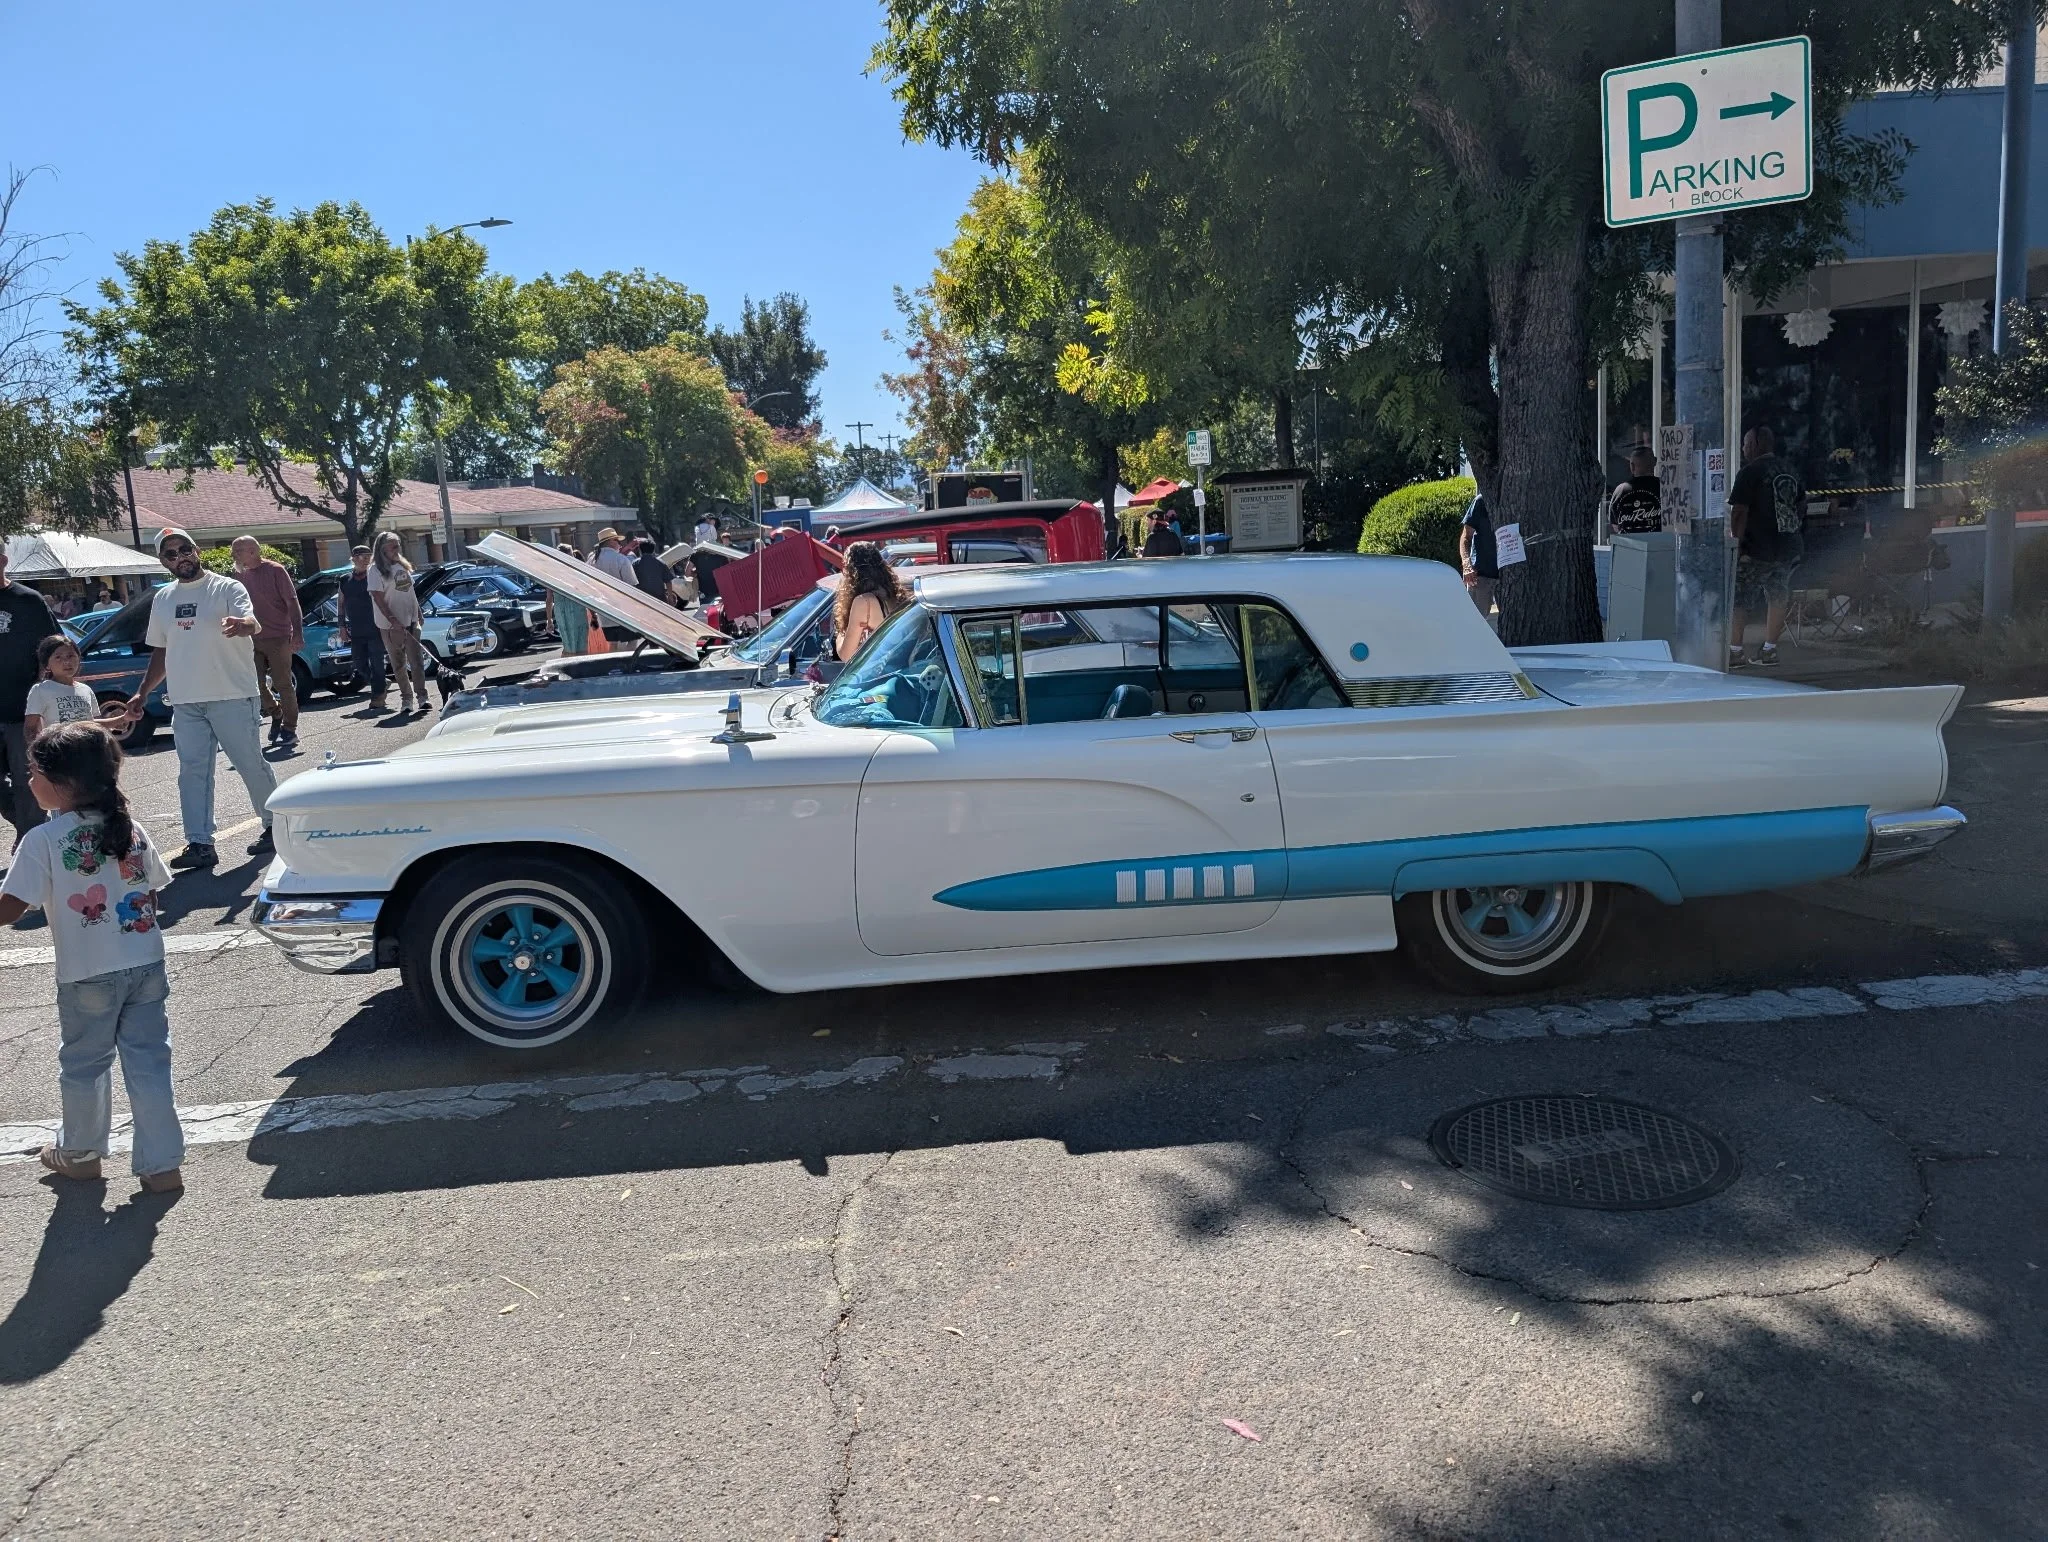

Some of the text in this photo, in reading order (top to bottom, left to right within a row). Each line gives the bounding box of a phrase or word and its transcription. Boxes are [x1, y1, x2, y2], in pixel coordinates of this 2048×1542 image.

[1627, 82, 1785, 200] PARKING
[1668, 186, 1744, 209] 1 BLOCK
[1660, 429, 1684, 448] YARD
[1661, 448, 1681, 462] SALE
[294, 825, 432, 842] Thunderbird
